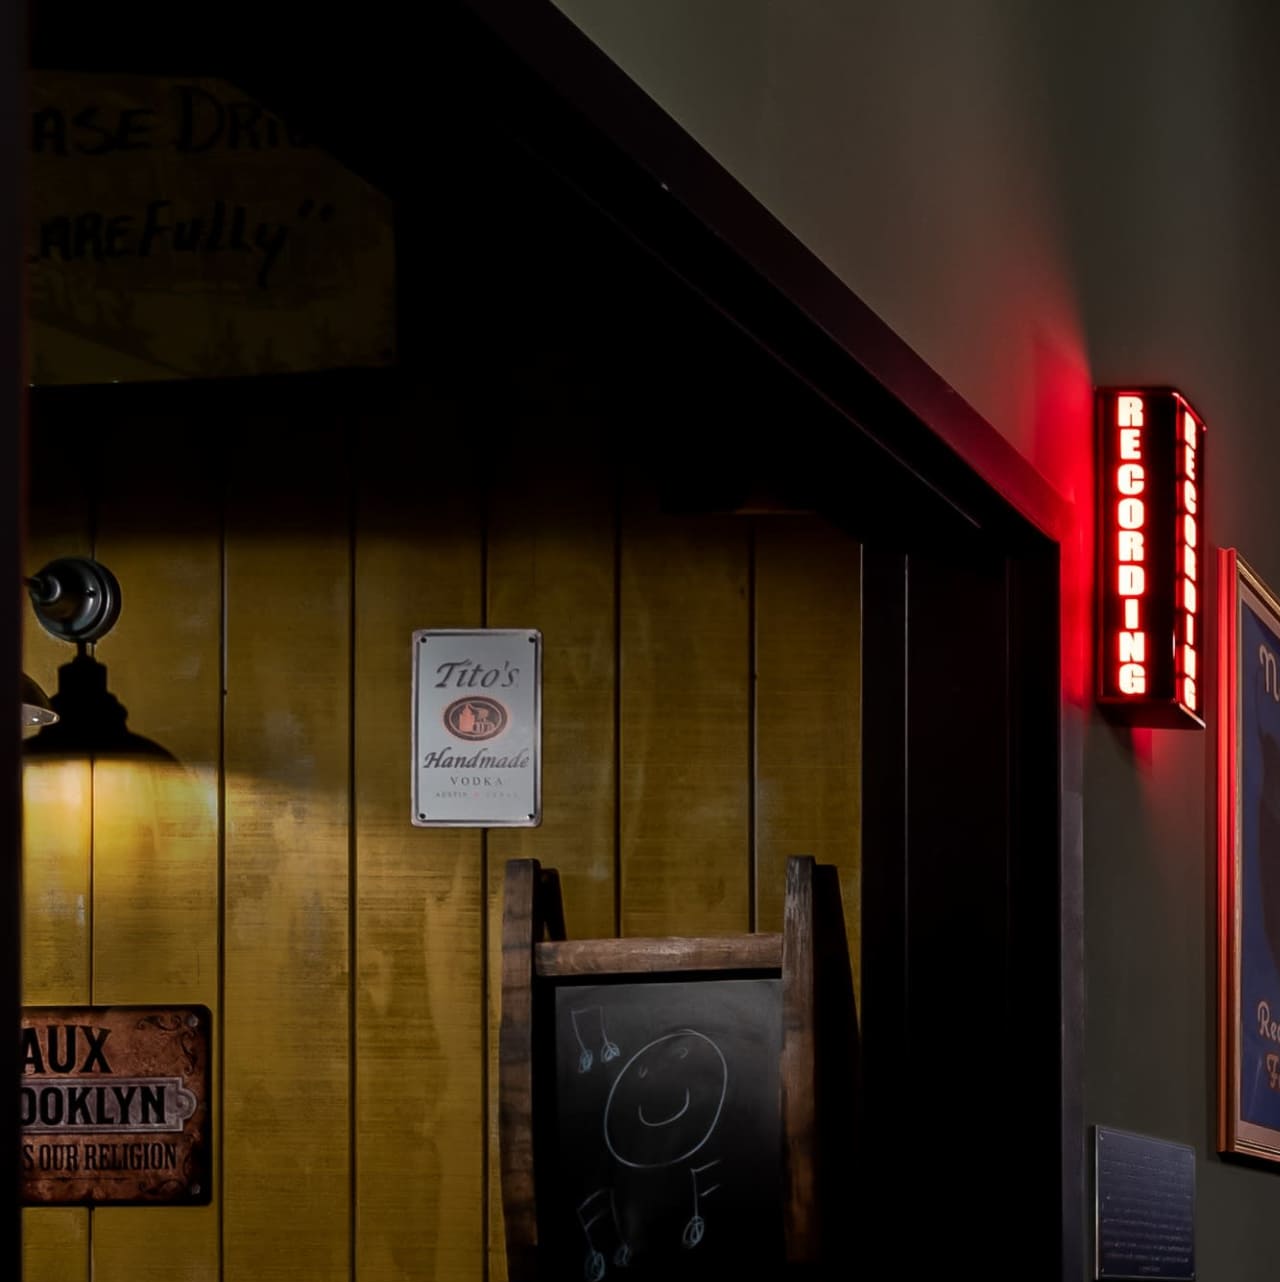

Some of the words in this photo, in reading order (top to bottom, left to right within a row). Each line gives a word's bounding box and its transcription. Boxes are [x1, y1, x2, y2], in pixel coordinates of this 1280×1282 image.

[1116, 394, 1147, 695] RECORDING
[435, 658, 520, 689] Tito's
[423, 747, 530, 769] Handmade
[450, 775, 503, 786] VODKA
[22, 1025, 113, 1074] AUX
[39, 1144, 79, 1171] OUR
[85, 1143, 177, 1170] RELIGION
